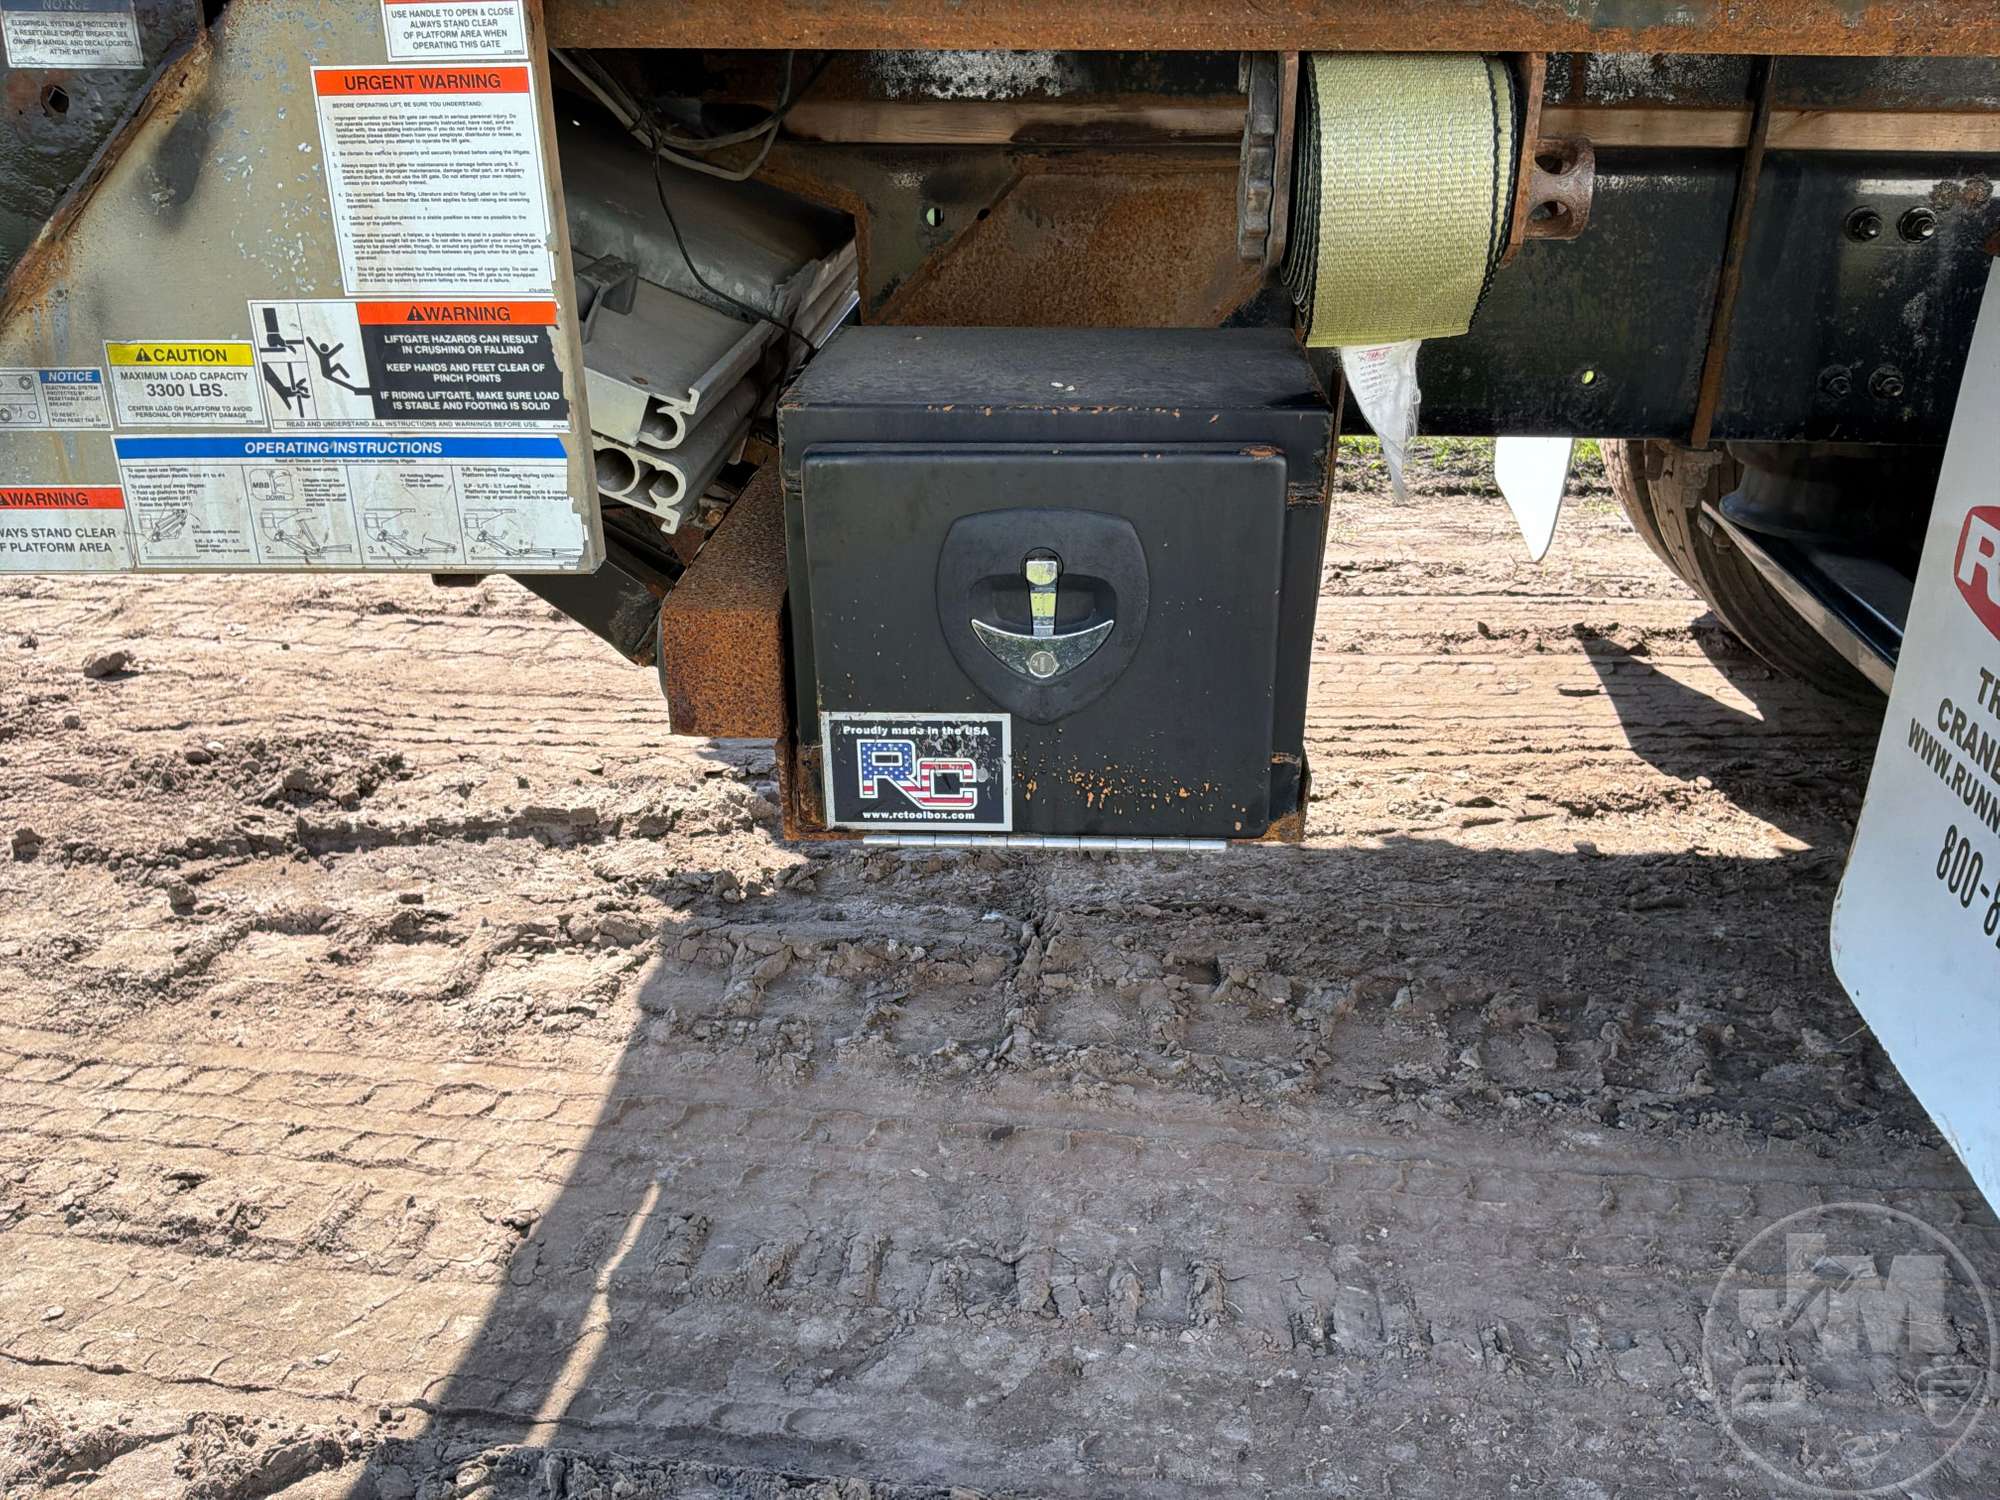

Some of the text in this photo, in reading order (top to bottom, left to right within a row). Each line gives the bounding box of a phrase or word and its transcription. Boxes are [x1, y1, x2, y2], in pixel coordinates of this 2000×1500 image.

[390, 7, 513, 18] USE HANDLE TO OPEN & CLOSE
[410, 18, 497, 29] ALWAYS STAND CLEAR
[403, 29, 507, 39] OF PLATFORM AREA WHEN
[412, 39, 500, 50] OPERATING THIS GATE
[344, 74, 500, 90] URGENT WARNING
[423, 306, 511, 321] WARNING
[384, 335, 537, 344] LIFTGATE HAZARDS CAN RESULT
[402, 345, 523, 355] IN CRUSHING OR FALLING
[153, 349, 227, 362] CAUTION
[386, 363, 544, 373] KEEP HANDS AND FEET CLEAR OF
[48, 372, 92, 381] NOTICE
[120, 372, 247, 381] MAXIMUM LOAD CAPACITY
[433, 374, 500, 383] PINCH POINTS
[146, 384, 226, 397] 3300 LBS.
[380, 391, 559, 400] IF RIDING LIFTGATE, MAKE SURE LOAD
[393, 401, 550, 410] IS STABLE AND FOOTING IS SOLID
[245, 442, 441, 454] OPERATING INSTRUCTIONS
[8, 492, 88, 506] WARNING
[31, 528, 71, 538] STAND
[75, 528, 116, 538] CLEAR
[10, 542, 75, 552] PLATFORM
[79, 542, 112, 552] AREA
[144, 546, 152, 554] 1.
[265, 545, 274, 553] 2.
[367, 546, 375, 554] 3.
[469, 546, 478, 554] 4.
[843, 726, 988, 736] Proudly made in the USA
[857, 739, 978, 810] RC
[863, 811, 974, 820] www.rctoolbox.com
